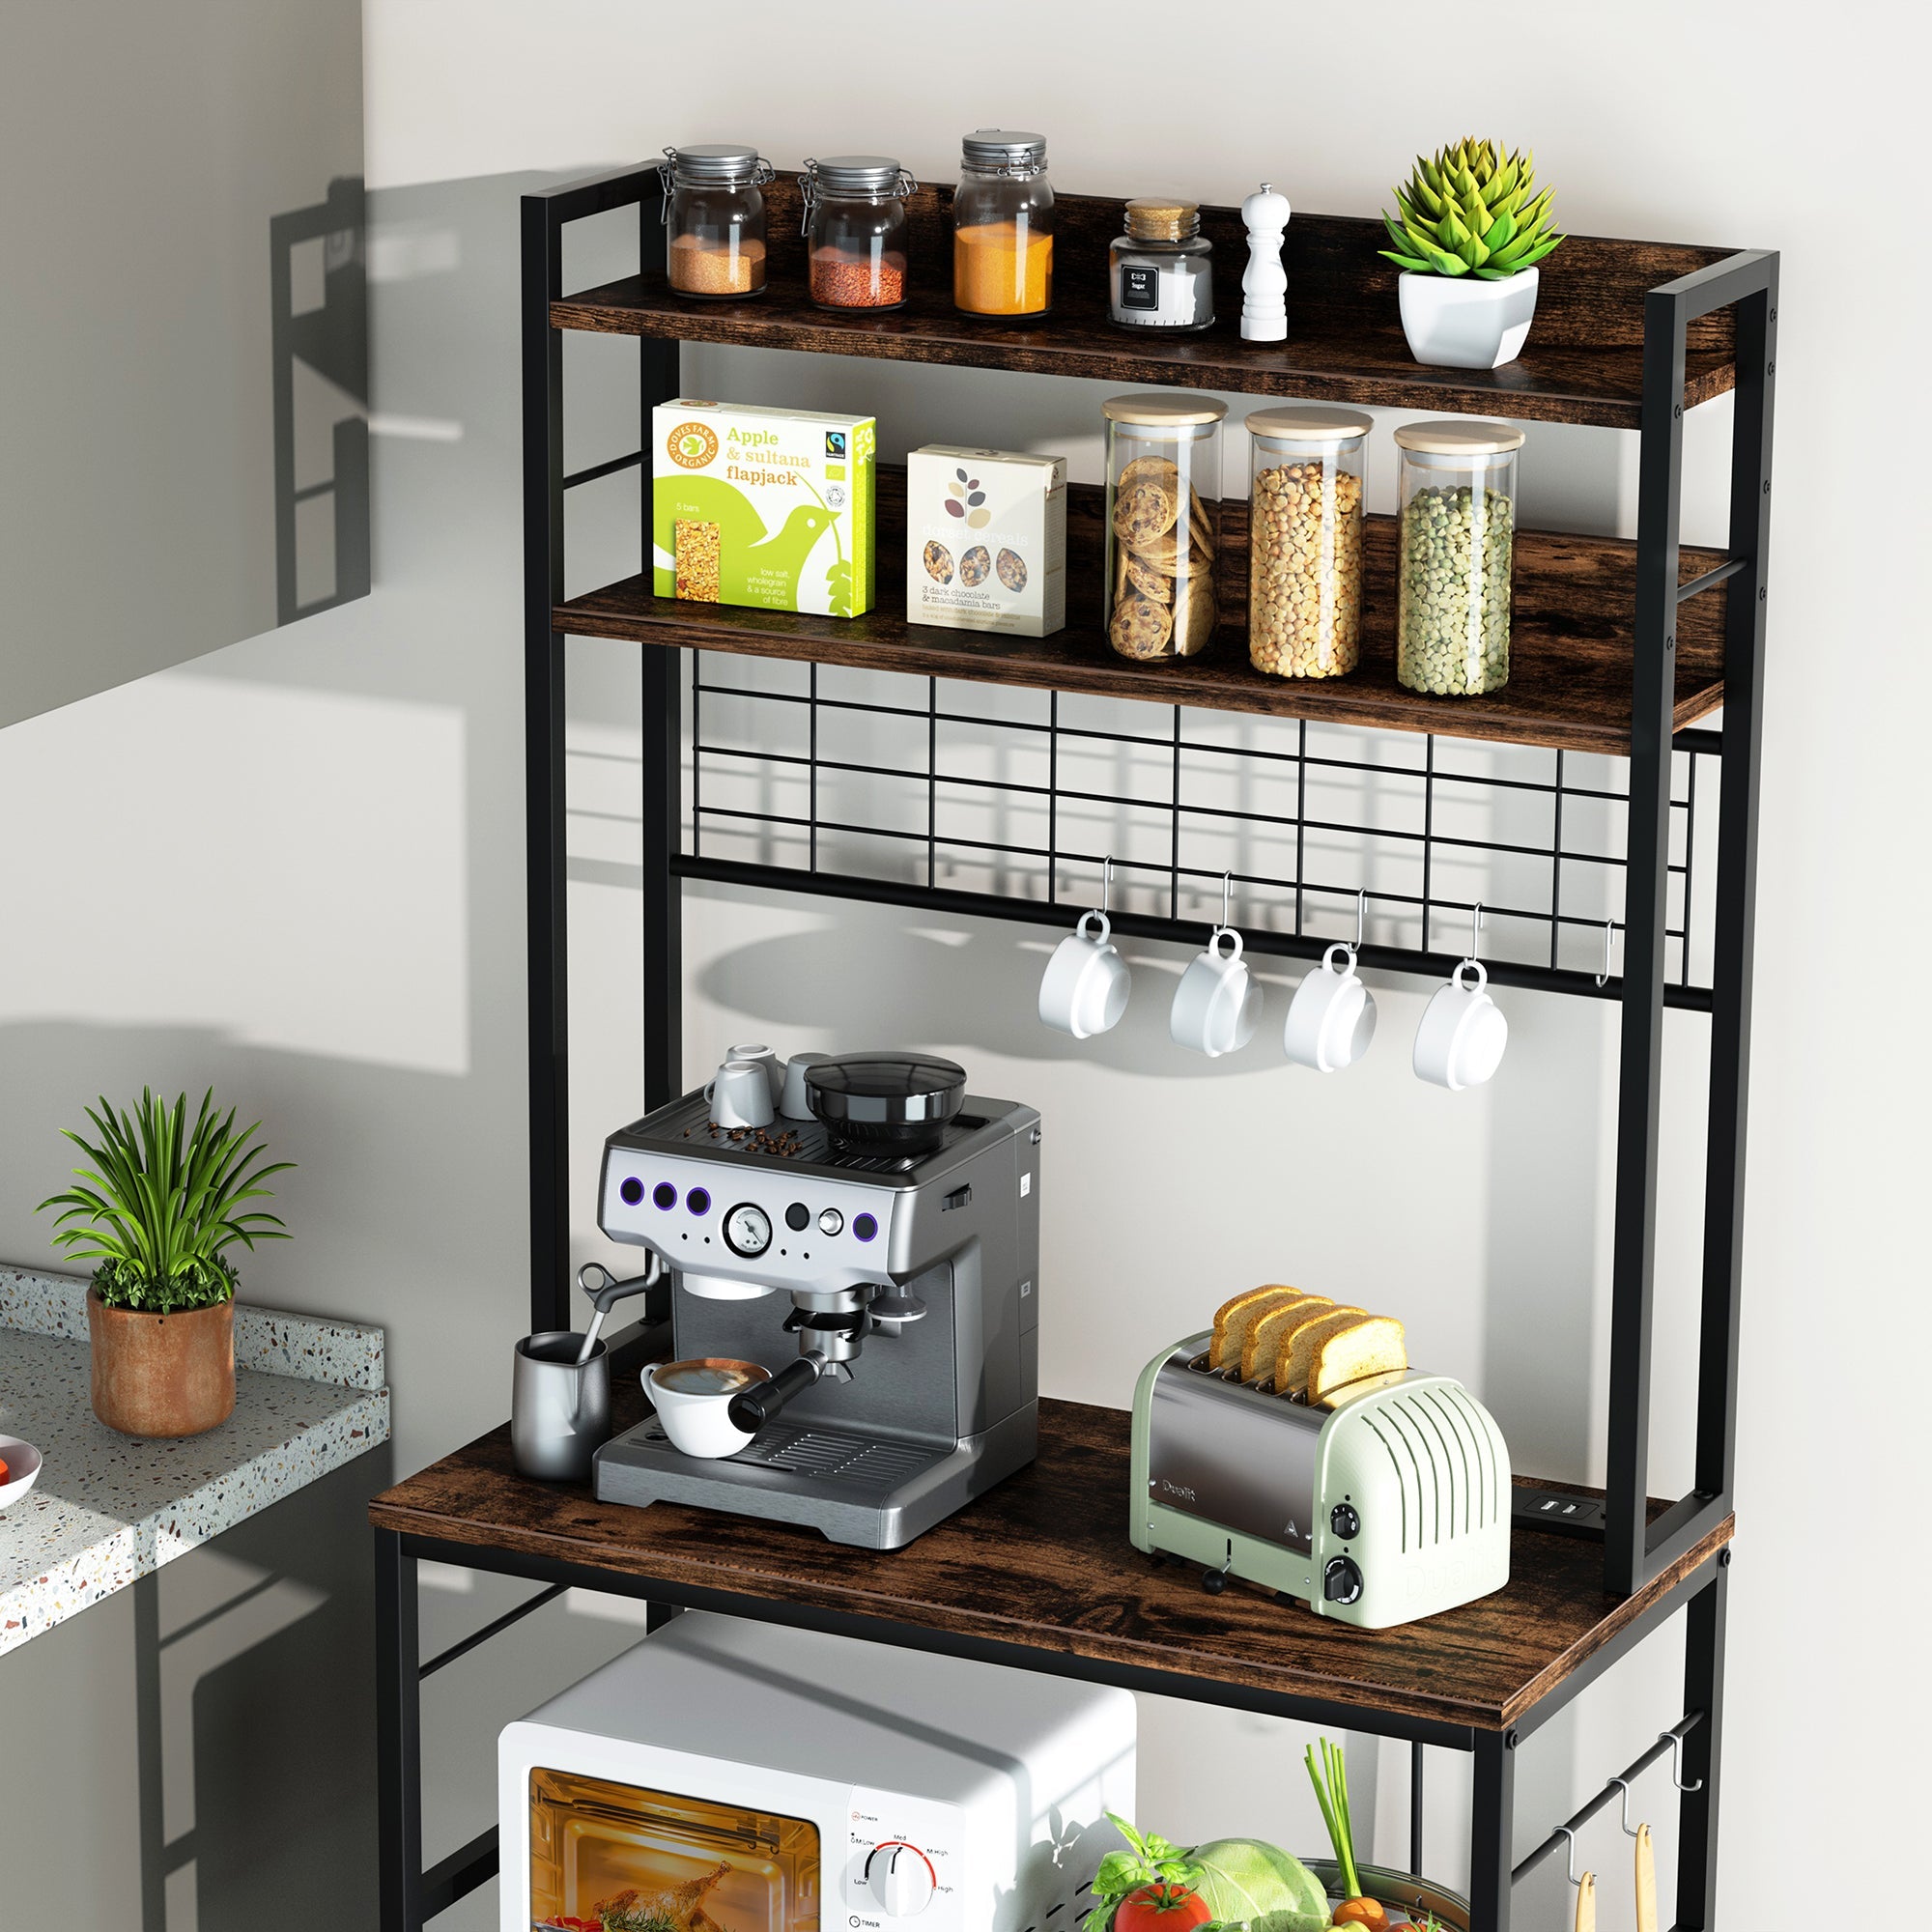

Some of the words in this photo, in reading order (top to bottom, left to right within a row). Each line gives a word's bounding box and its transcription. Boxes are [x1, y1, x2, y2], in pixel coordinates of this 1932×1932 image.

[669, 425, 691, 451] DOVES
[693, 425, 716, 444] FARM
[726, 427, 779, 446] Apple
[675, 448, 715, 467] ORGANIC
[726, 447, 741, 461] &
[745, 449, 811, 469] sultana
[726, 466, 798, 487] flapjack
[676, 501, 682, 511] 5
[683, 503, 700, 513] bars
[974, 531, 1029, 547] cereals
[760, 568, 774, 577] low
[747, 577, 786, 587] wholegrain
[760, 587, 786, 597] source
[929, 587, 950, 596] dark
[951, 588, 990, 600] chocolate
[772, 596, 788, 606] fibre
[931, 596, 980, 608] macadamia
[981, 601, 1001, 610] bars
[1162, 1479, 1196, 1502] Dualit
[1404, 1544, 1501, 1599] Dualit
[862, 1919, 880, 1929] TIMER
